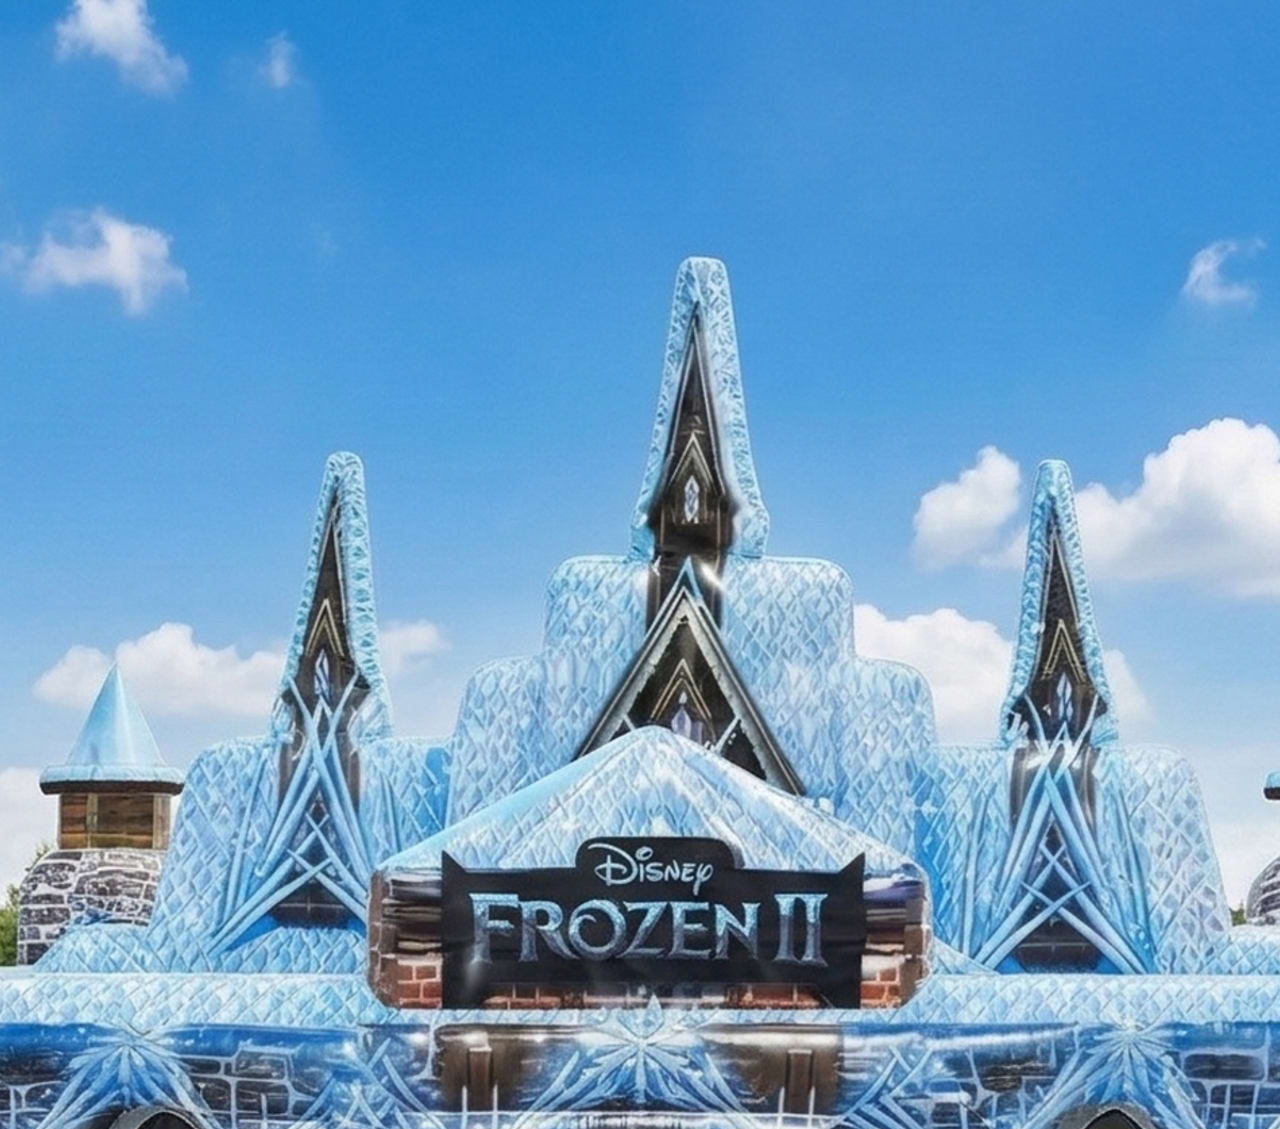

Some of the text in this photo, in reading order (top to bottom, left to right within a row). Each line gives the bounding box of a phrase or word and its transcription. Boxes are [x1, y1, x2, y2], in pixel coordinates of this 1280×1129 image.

[587, 843, 714, 895] Disney
[469, 893, 828, 967] FROZEN II
